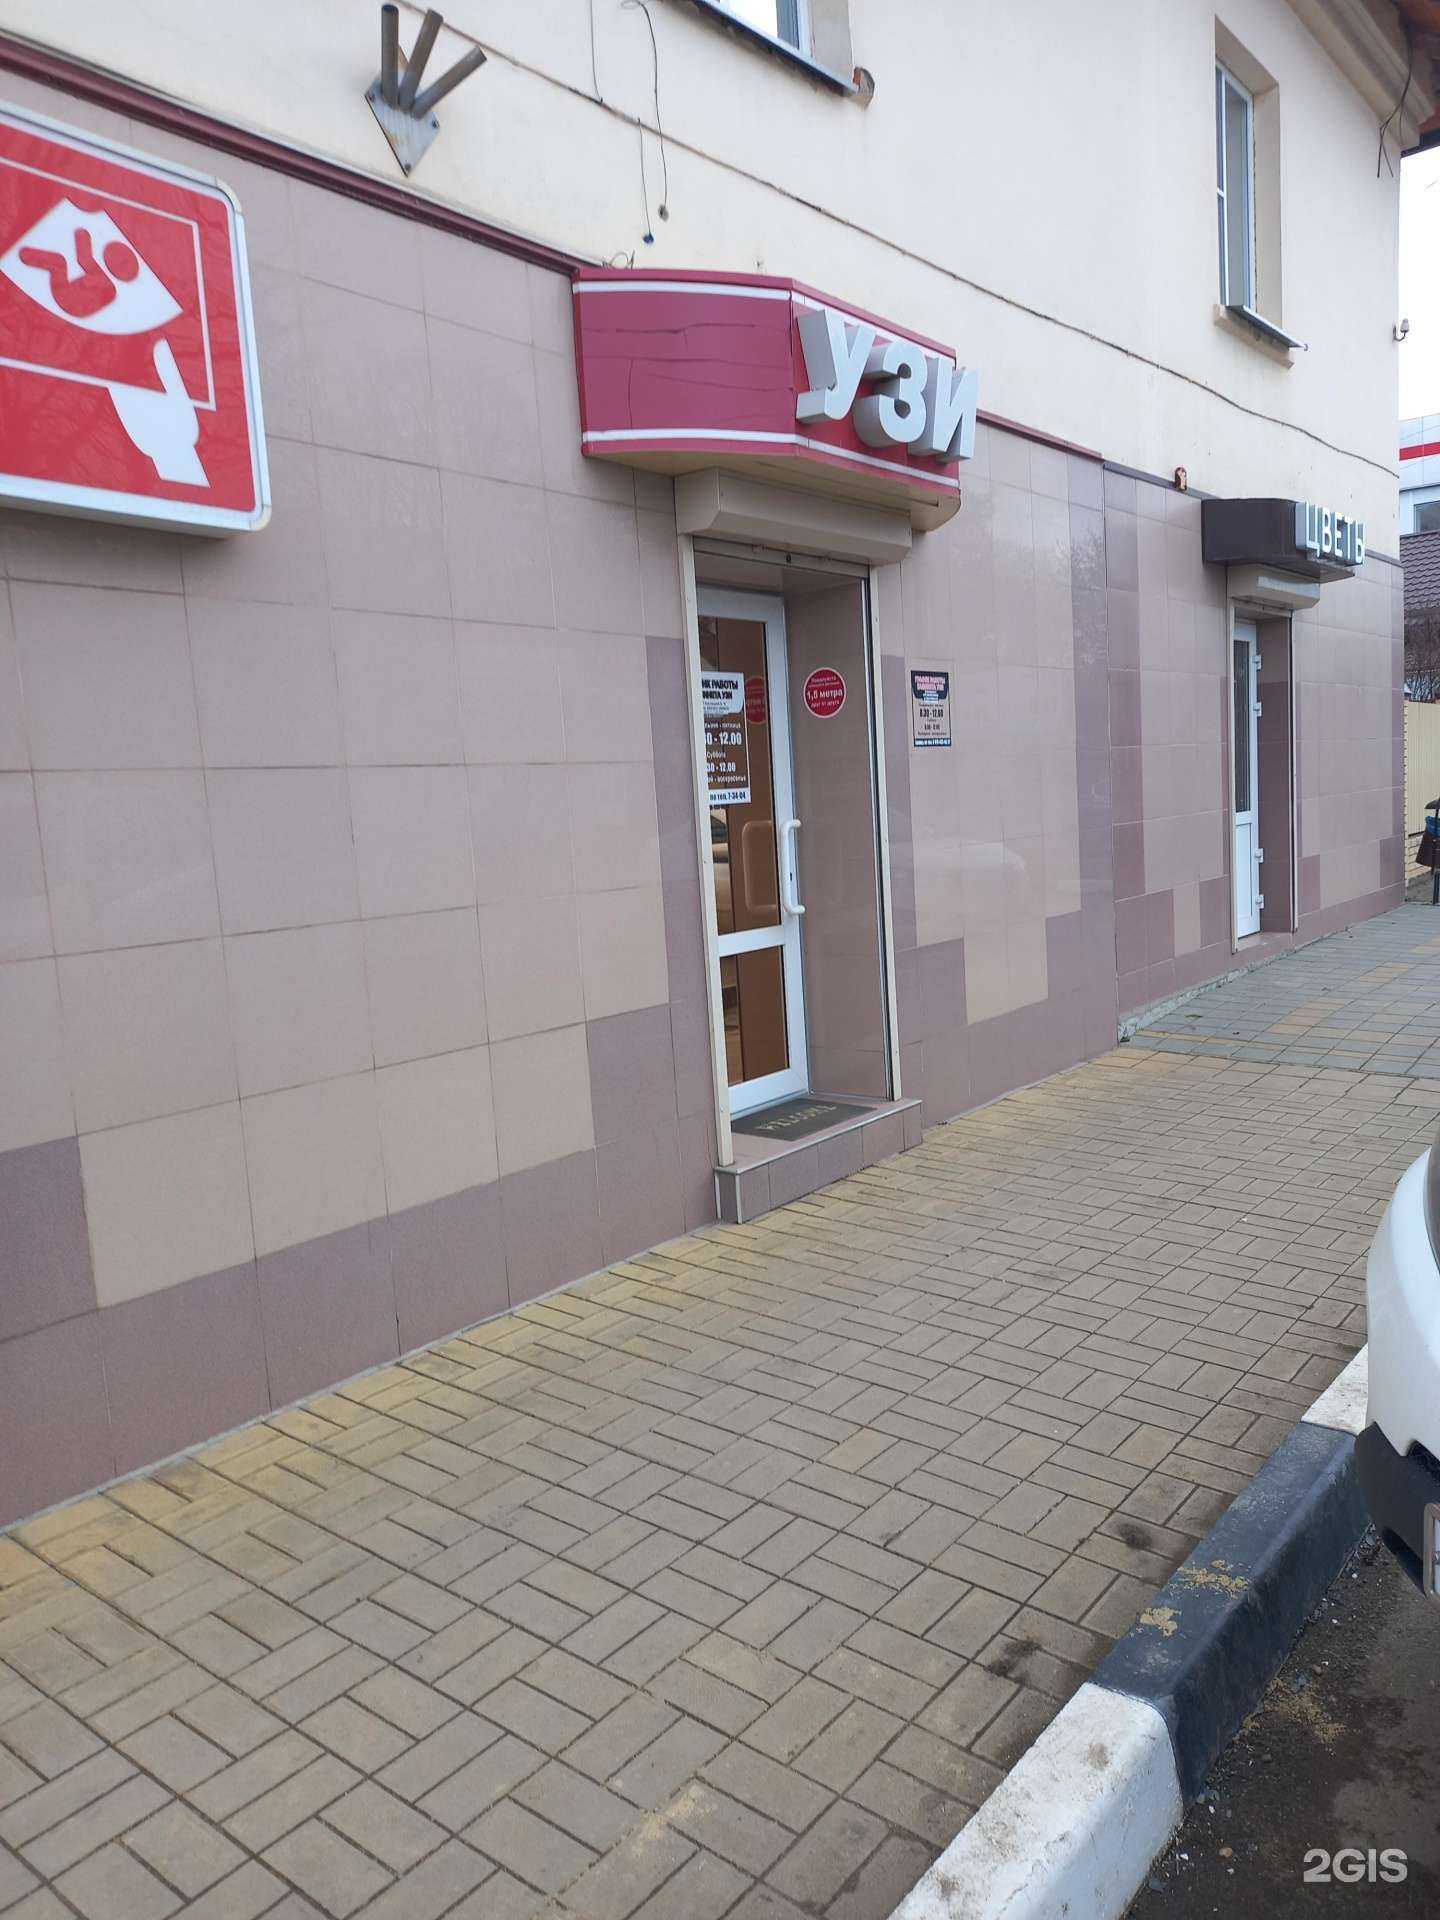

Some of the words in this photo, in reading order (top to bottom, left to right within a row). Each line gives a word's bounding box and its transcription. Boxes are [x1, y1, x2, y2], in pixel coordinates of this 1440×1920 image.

[798, 309, 977, 460] УЗИ
[711, 679, 739, 690] РАБОТЫ
[819, 689, 843, 699] метра
[719, 731, 742, 745] 12.00
[719, 761, 736, 773] 12.00
